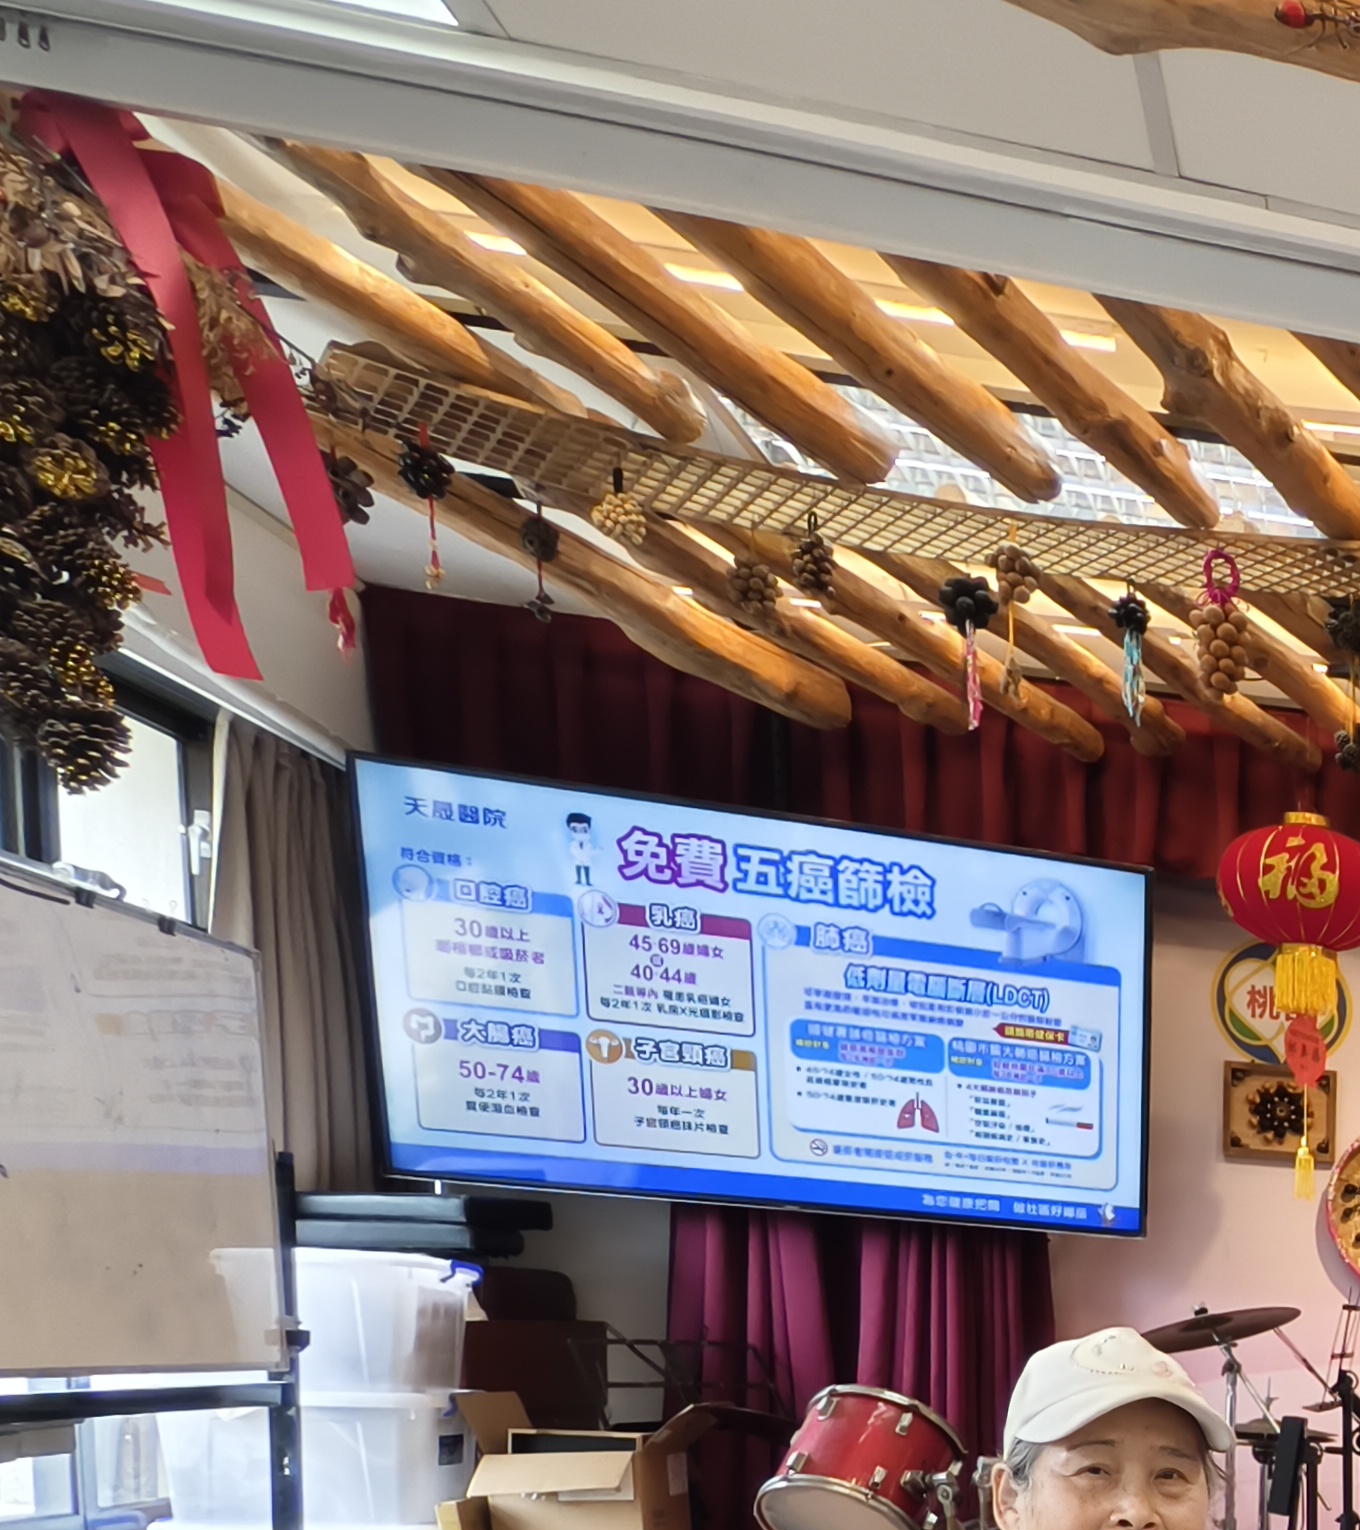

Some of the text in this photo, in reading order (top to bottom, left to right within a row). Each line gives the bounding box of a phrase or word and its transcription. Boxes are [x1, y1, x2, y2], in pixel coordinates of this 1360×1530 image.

[403, 795, 507, 829] 天晟醫院
[616, 825, 937, 921] 免費五癌篩檢
[1258, 836, 1339, 909] 福
[454, 917, 531, 943] 30歲以上
[650, 902, 698, 931] 乳癌
[813, 923, 872, 955] 肺癌
[460, 1019, 537, 1048] 大腸癌
[634, 1037, 728, 1068] 子宮頸癌
[458, 1060, 541, 1084] 50-74歲
